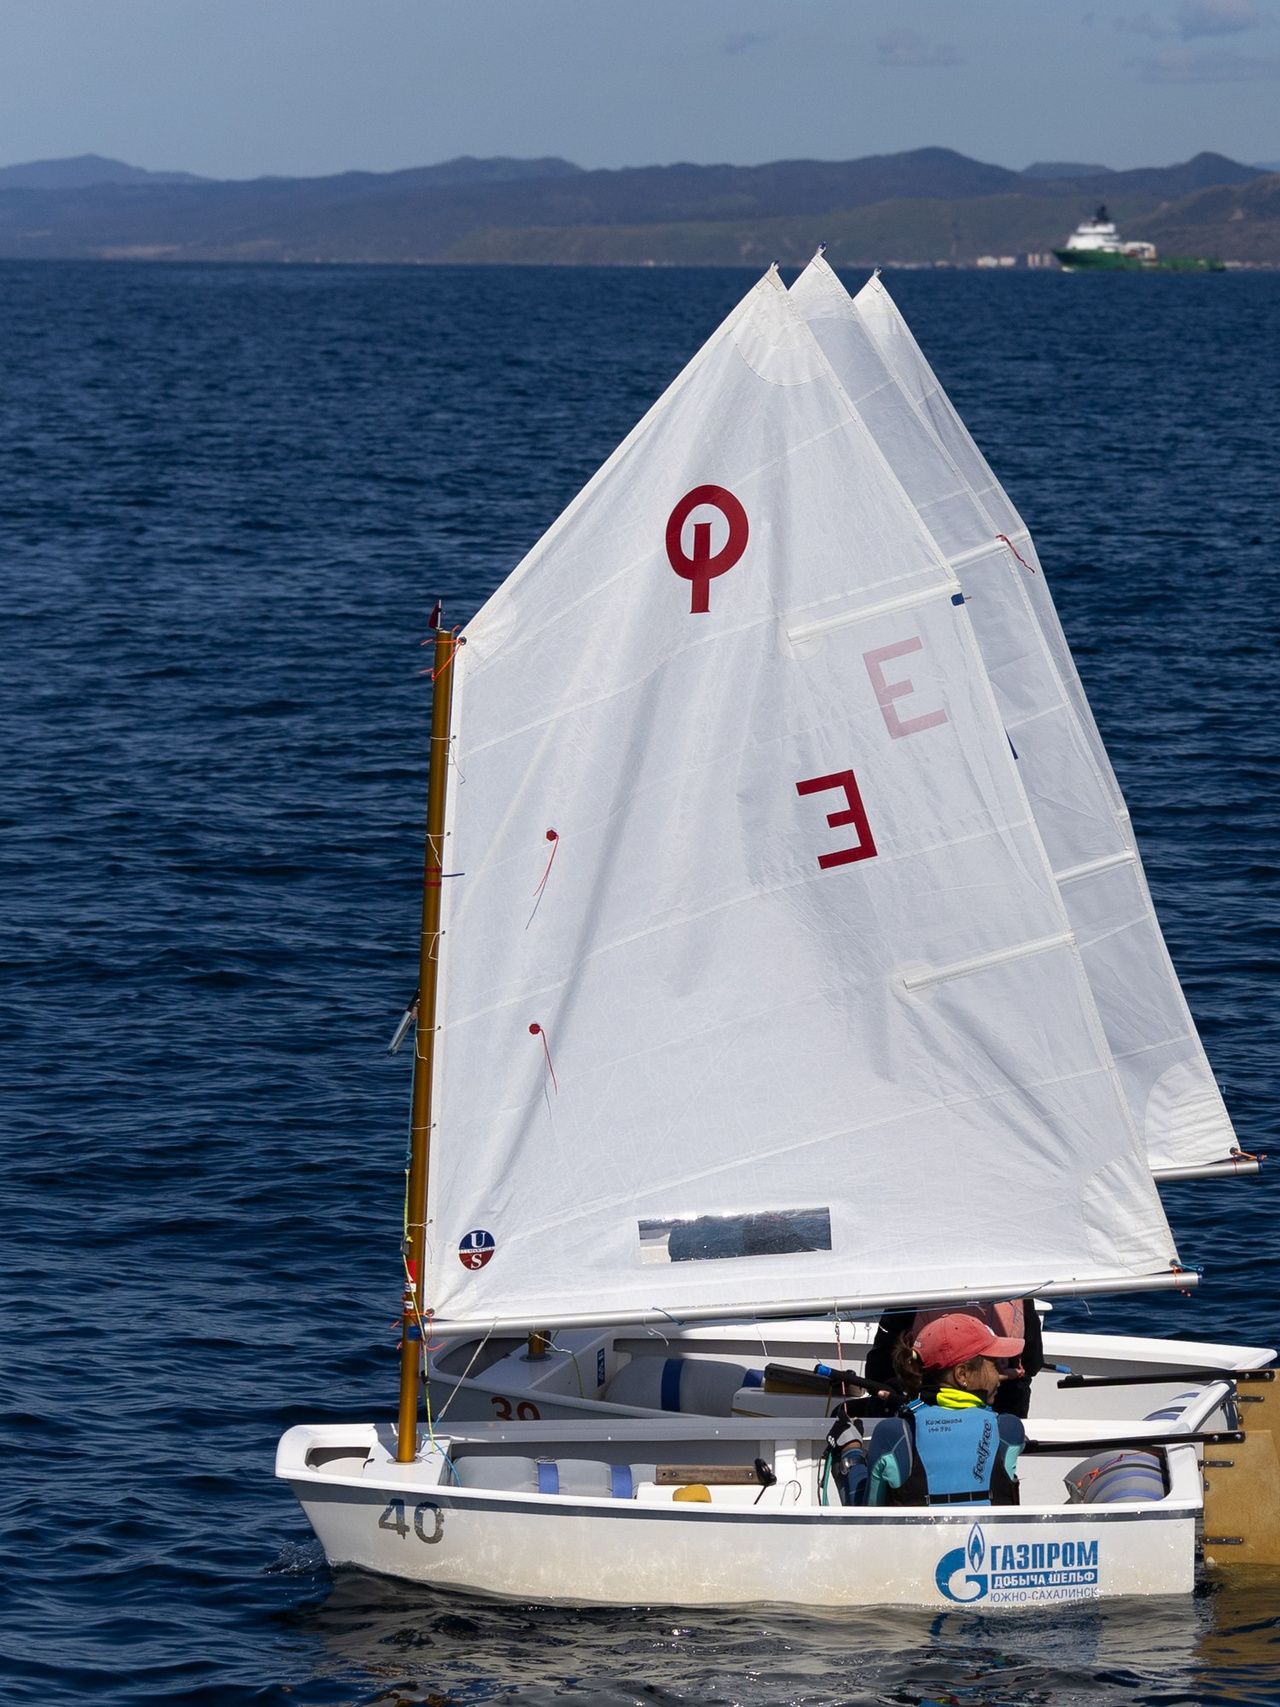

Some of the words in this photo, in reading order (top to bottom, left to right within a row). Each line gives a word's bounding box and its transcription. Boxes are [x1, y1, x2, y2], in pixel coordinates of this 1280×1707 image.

[378, 1498, 445, 1544] 40
[990, 1540, 1099, 1571] ГАЗПРОМ
[994, 1572, 1047, 1589] ДОБЫЧА
[1048, 1571, 1096, 1586] ШЕЛЬФ
[990, 1587, 1099, 1603] ЮЖНО-САХАЛИНСК
